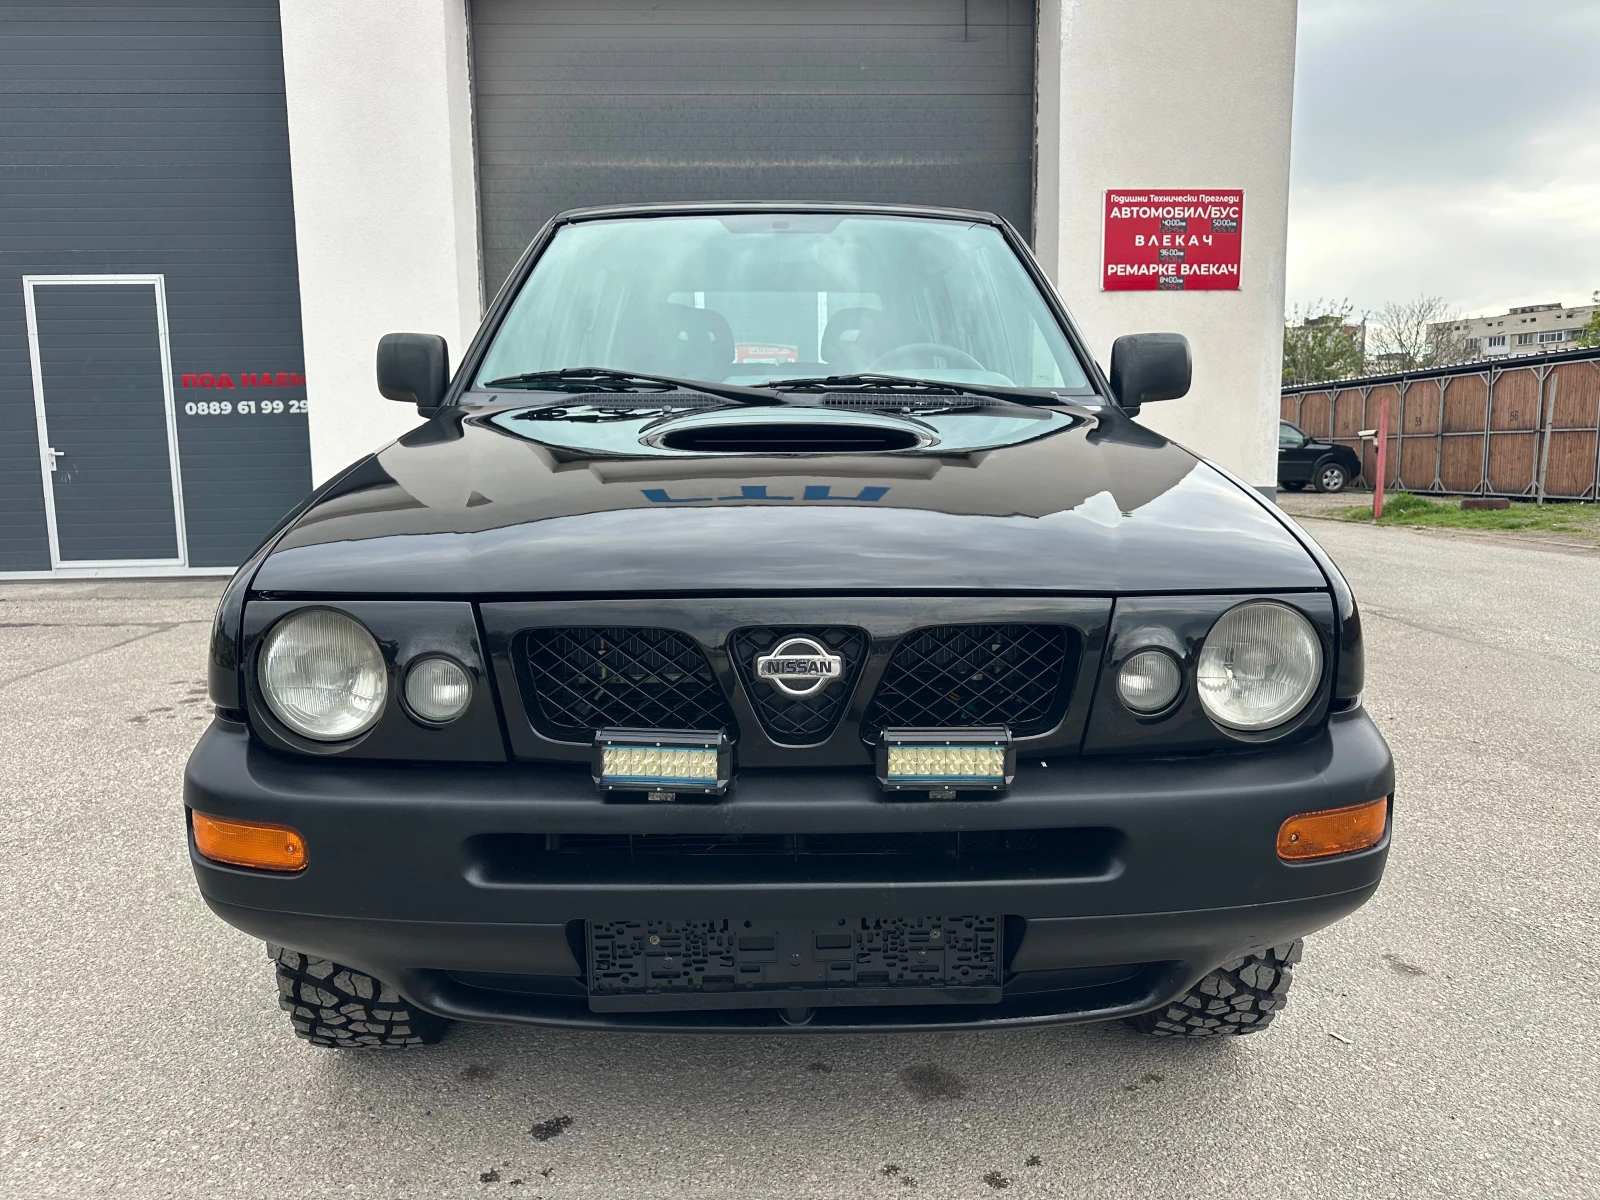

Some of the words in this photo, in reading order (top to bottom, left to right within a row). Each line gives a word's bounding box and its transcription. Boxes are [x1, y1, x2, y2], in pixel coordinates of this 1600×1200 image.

[1110, 194, 1148, 204] Годишни
[1150, 194, 1197, 203] Технически
[1199, 194, 1239, 204] Прегледи
[1110, 205, 1239, 219] АВТОМОБИЛ/БУС
[1107, 264, 1176, 276] РЕМАРКЕ
[1180, 264, 1238, 275] ВЛЕКАЧ
[181, 374, 235, 390] ПОД
[184, 401, 232, 415] 0889
[237, 400, 256, 414] 61
[260, 400, 284, 414] 99
[288, 399, 309, 414] 29
[767, 661, 832, 674] NISSAN
